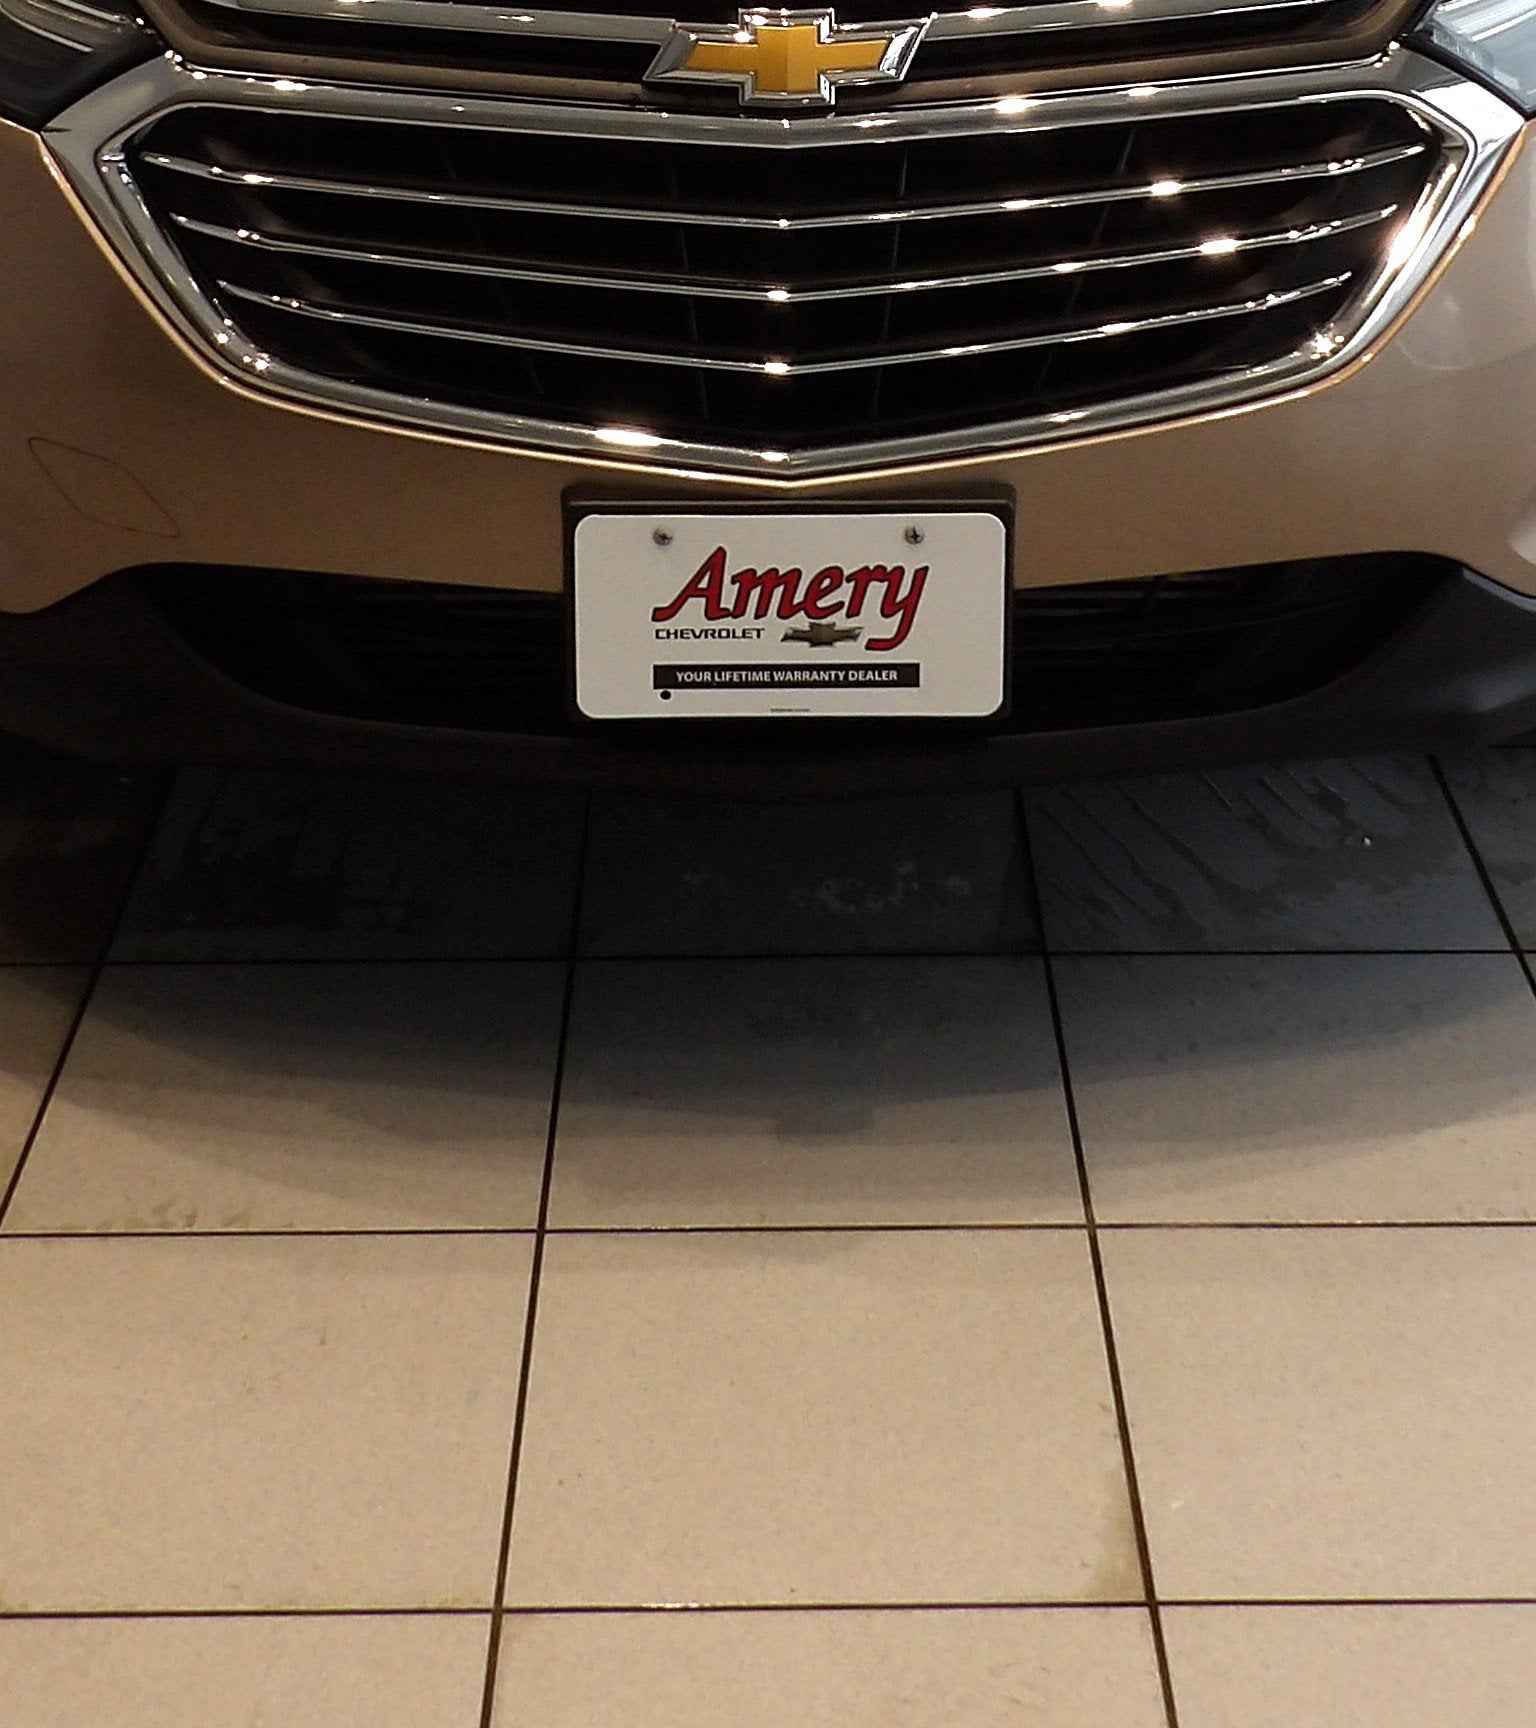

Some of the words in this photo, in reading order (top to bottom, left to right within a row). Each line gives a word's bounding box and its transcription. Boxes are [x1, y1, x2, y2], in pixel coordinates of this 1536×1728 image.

[651, 545, 930, 651] Amery
[654, 627, 765, 640] CHEVROLET
[675, 671, 712, 684] YOUR
[714, 670, 770, 683] LIFETIME
[773, 669, 846, 682] WARRANTY
[848, 669, 899, 681] DEALER
